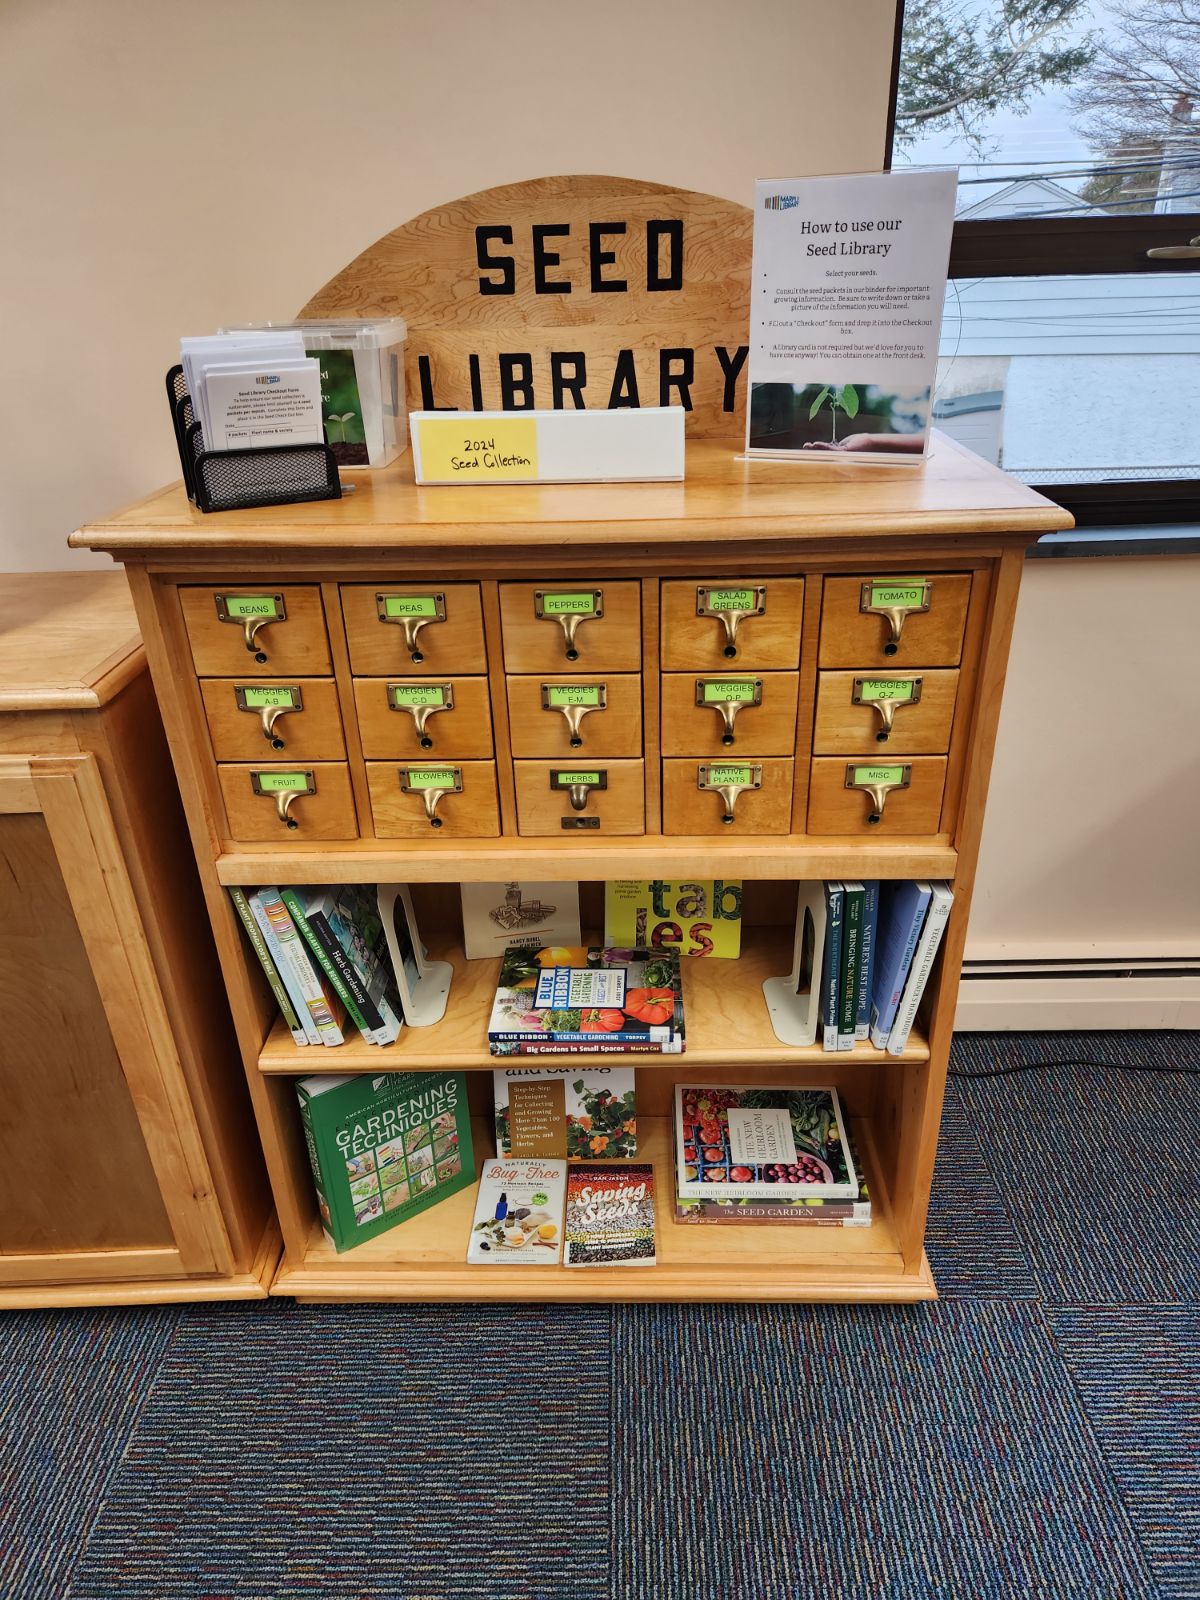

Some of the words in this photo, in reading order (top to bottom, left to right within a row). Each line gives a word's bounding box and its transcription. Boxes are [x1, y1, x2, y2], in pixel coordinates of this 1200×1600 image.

[800, 221, 832, 234] How
[835, 220, 848, 233] to
[852, 222, 874, 232] use
[877, 220, 902, 231] our
[475, 220, 683, 295] SEED
[806, 243, 836, 256] Seed
[840, 242, 892, 258] Library
[418, 346, 749, 412] LIBRARY
[464, 439, 495, 451] 2024
[451, 456, 480, 470] Seed
[484, 454, 531, 468] Collection
[400, 604, 423, 612] PEAS
[548, 600, 590, 609] PEPPERS
[713, 601, 750, 610] GREENS
[717, 592, 747, 600] SALAD
[878, 591, 918, 601] TOMATO
[240, 606, 269, 614] BEANS
[868, 681, 908, 689] VEGGIES
[879, 691, 894, 699] Q-Z
[413, 772, 454, 780] FLOWERS
[234, 892, 243, 903] THE
[240, 904, 251, 921] PLANT
[648, 880, 742, 920] tab
[912, 910, 925, 923] Tiny
[636, 908, 714, 957] les
[862, 924, 872, 963] NATURE'S
[907, 922, 921, 948] Victory
[288, 900, 310, 932] COMPANION
[306, 932, 326, 960] PLANTING
[322, 960, 332, 970] FOR
[328, 970, 349, 998] BEGINNERS
[847, 929, 857, 968] BRINGING
[902, 946, 914, 971] Gardens
[332, 950, 345, 969] Herb
[343, 968, 366, 1004] Gardening
[539, 976, 554, 1000] BLUE
[554, 968, 570, 1008] RIBBON
[570, 973, 583, 1003] VEGETABLE
[581, 972, 593, 1003] GARDENING
[846, 969, 855, 1000] NATURE
[860, 966, 868, 986] BEST
[859, 988, 867, 1010] HOPE
[844, 1001, 853, 1022] HOME
[336, 1079, 457, 1146] GARDENING
[345, 1104, 375, 1119] AMERICAN
[338, 1094, 457, 1159] TECHNIQUES
[754, 1113, 767, 1159] HEIRLOOM
[767, 1125, 778, 1160] GARDEN
[576, 1183, 647, 1207] Saving
[582, 1199, 638, 1225] Seeds
